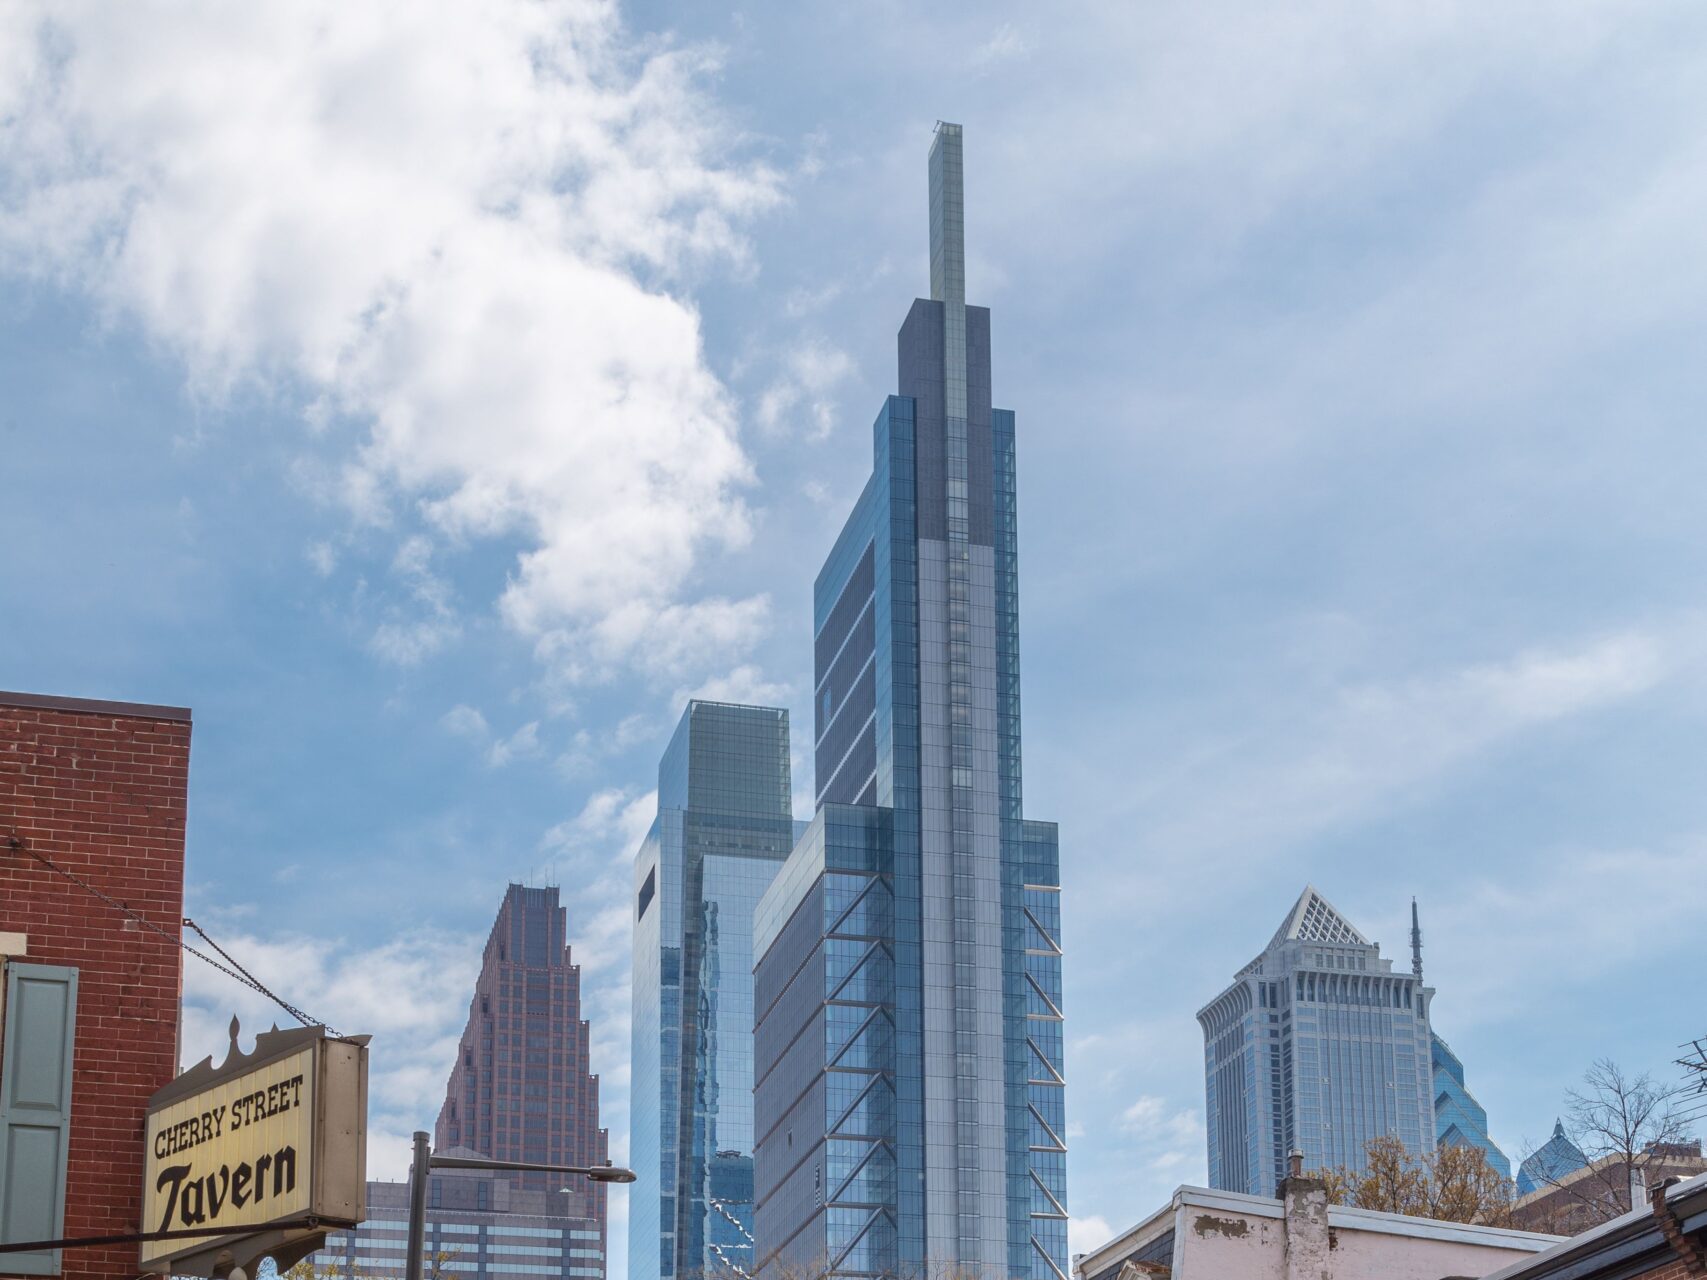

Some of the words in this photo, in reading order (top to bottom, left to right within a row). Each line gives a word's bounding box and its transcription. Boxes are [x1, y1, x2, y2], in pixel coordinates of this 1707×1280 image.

[154, 1105, 226, 1160] CHERRY
[231, 1074, 303, 1131] STREET
[156, 1145, 296, 1233] Tavern
